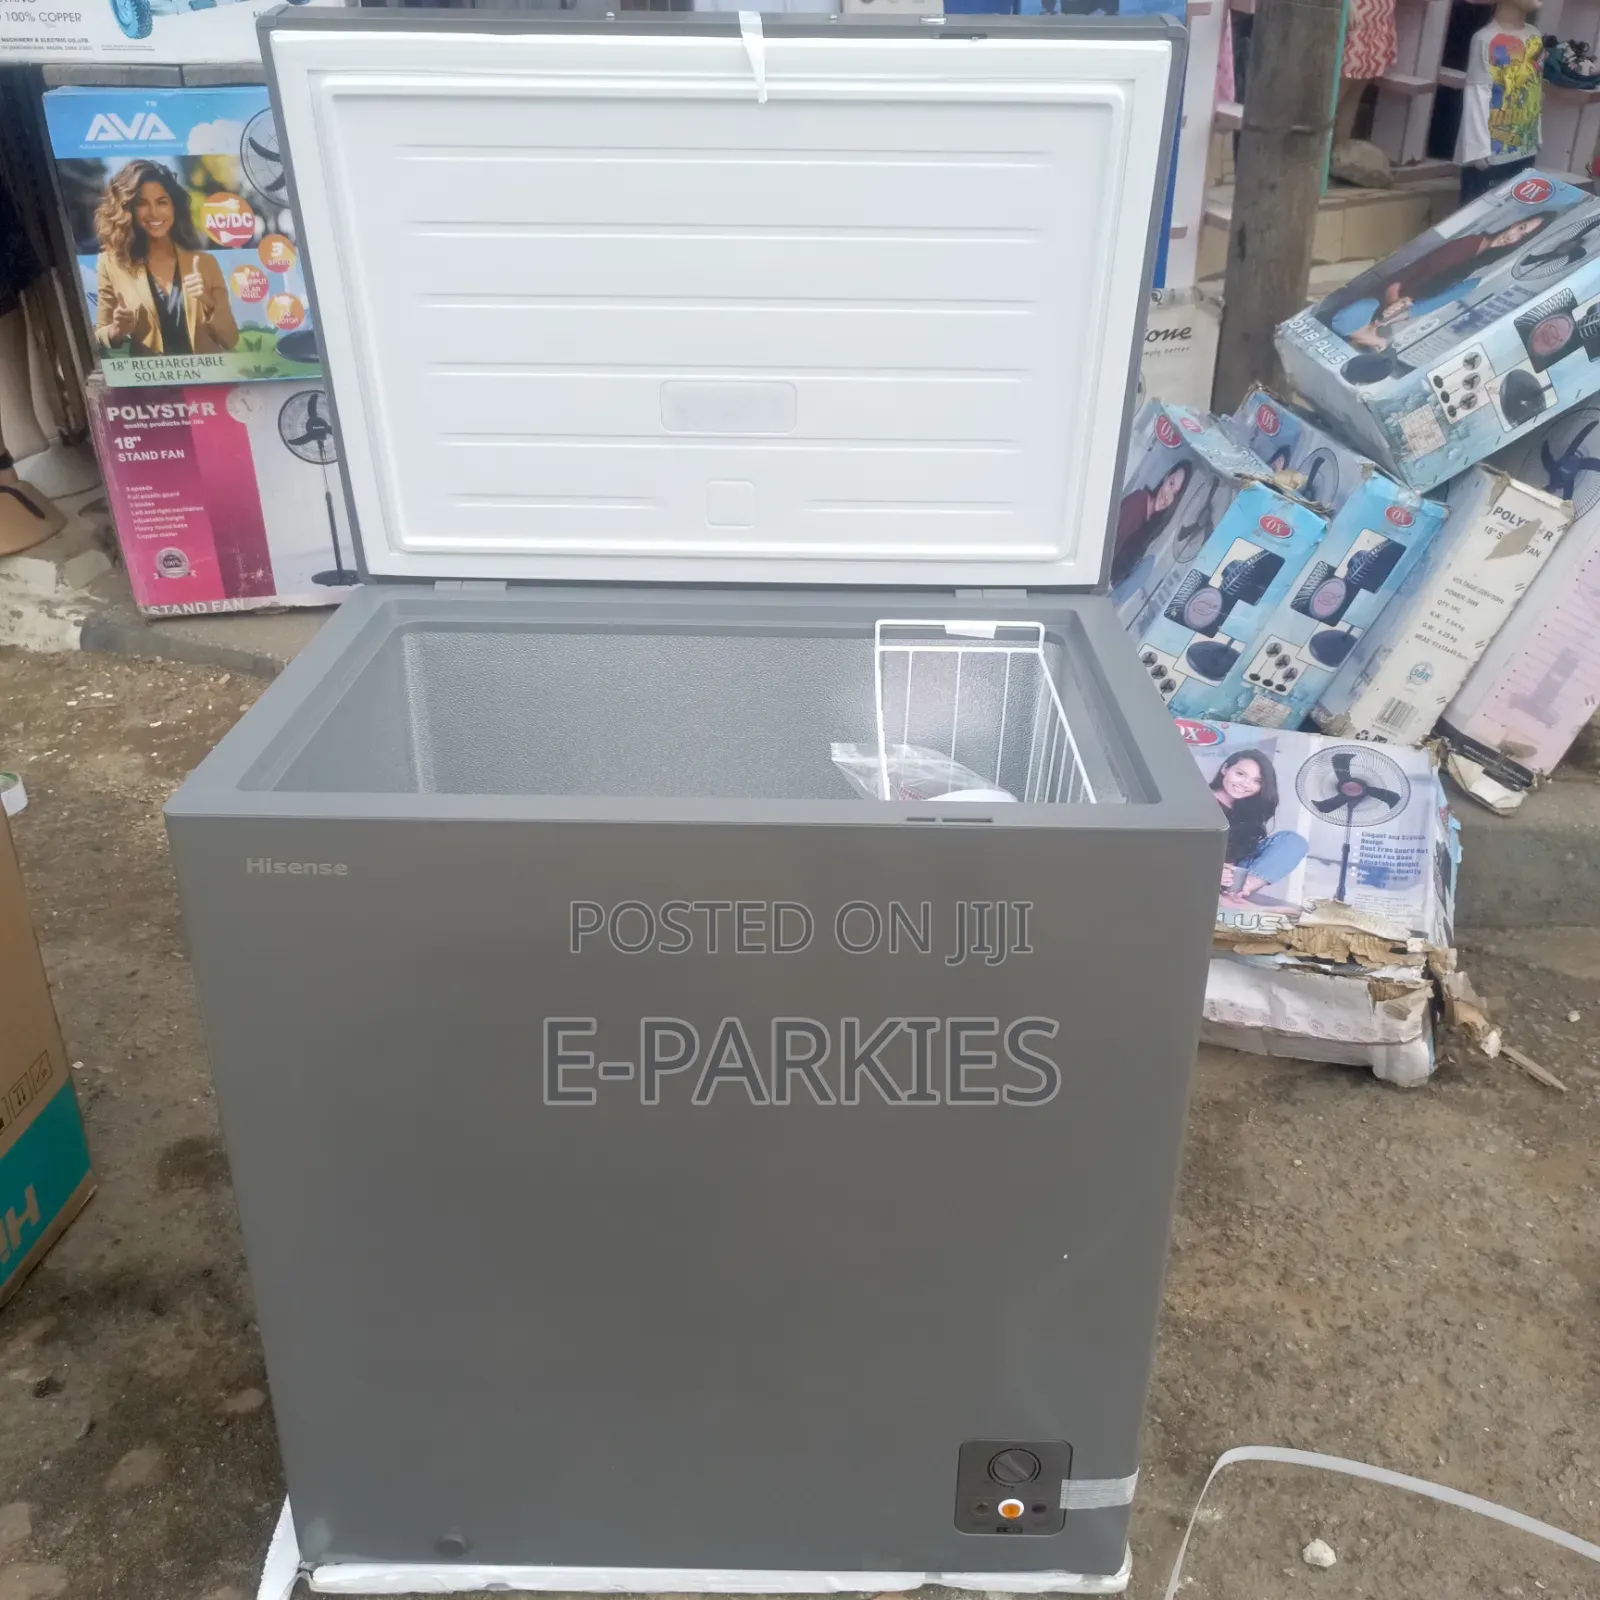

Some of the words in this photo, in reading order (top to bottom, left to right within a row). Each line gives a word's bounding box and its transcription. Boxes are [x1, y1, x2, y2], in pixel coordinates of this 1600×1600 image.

[5, 11, 36, 22] 100%
[39, 12, 82, 23] COPPER
[84, 112, 177, 142] AVA
[205, 212, 254, 229] AC/DC
[271, 242, 283, 257] 3
[110, 360, 129, 371] 18"
[132, 356, 226, 370] RECHARGEABLE
[135, 371, 175, 382] SOLAR
[177, 369, 202, 380] FAN
[118, 451, 159, 462] STAND
[161, 449, 185, 460] FAN
[212, 599, 245, 612] FAN
[245, 857, 349, 876] Hisense
